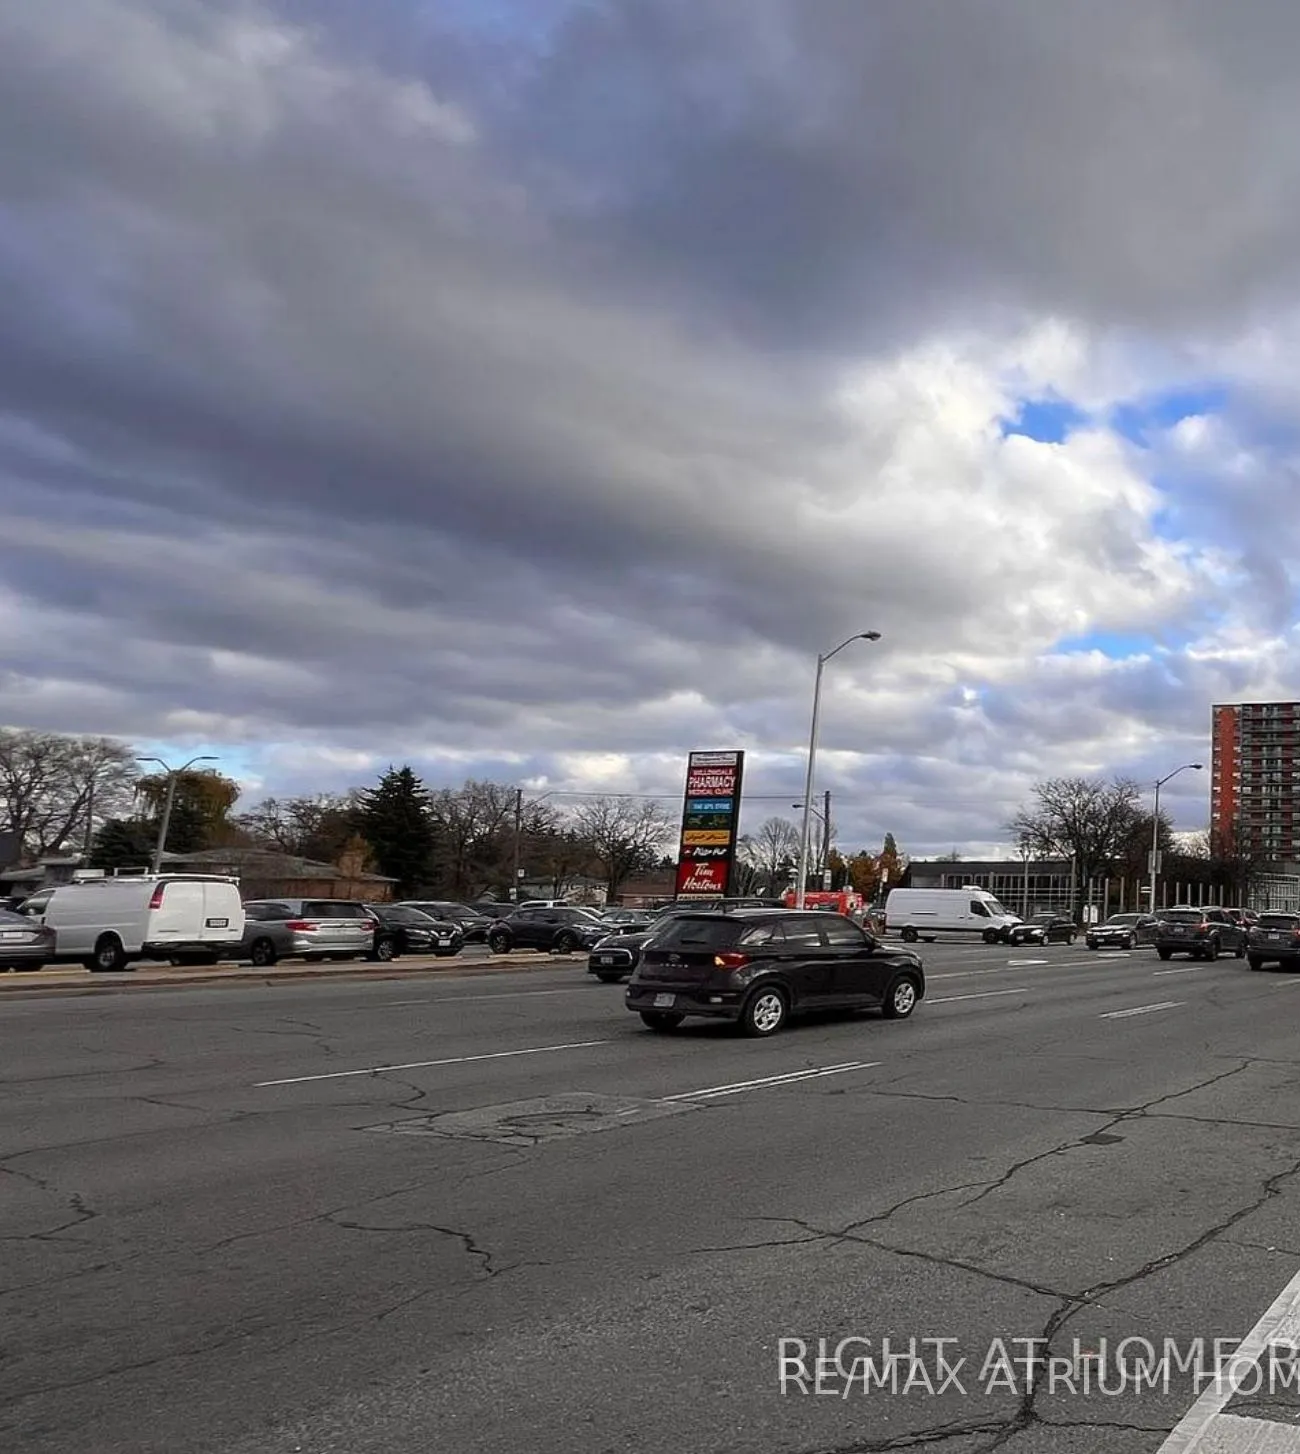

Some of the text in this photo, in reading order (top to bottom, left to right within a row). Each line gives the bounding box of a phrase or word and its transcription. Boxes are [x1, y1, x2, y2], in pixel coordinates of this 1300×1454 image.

[688, 775, 736, 788] PHARMACY
[695, 862, 715, 877] Tim
[683, 876, 722, 890] Hortons
